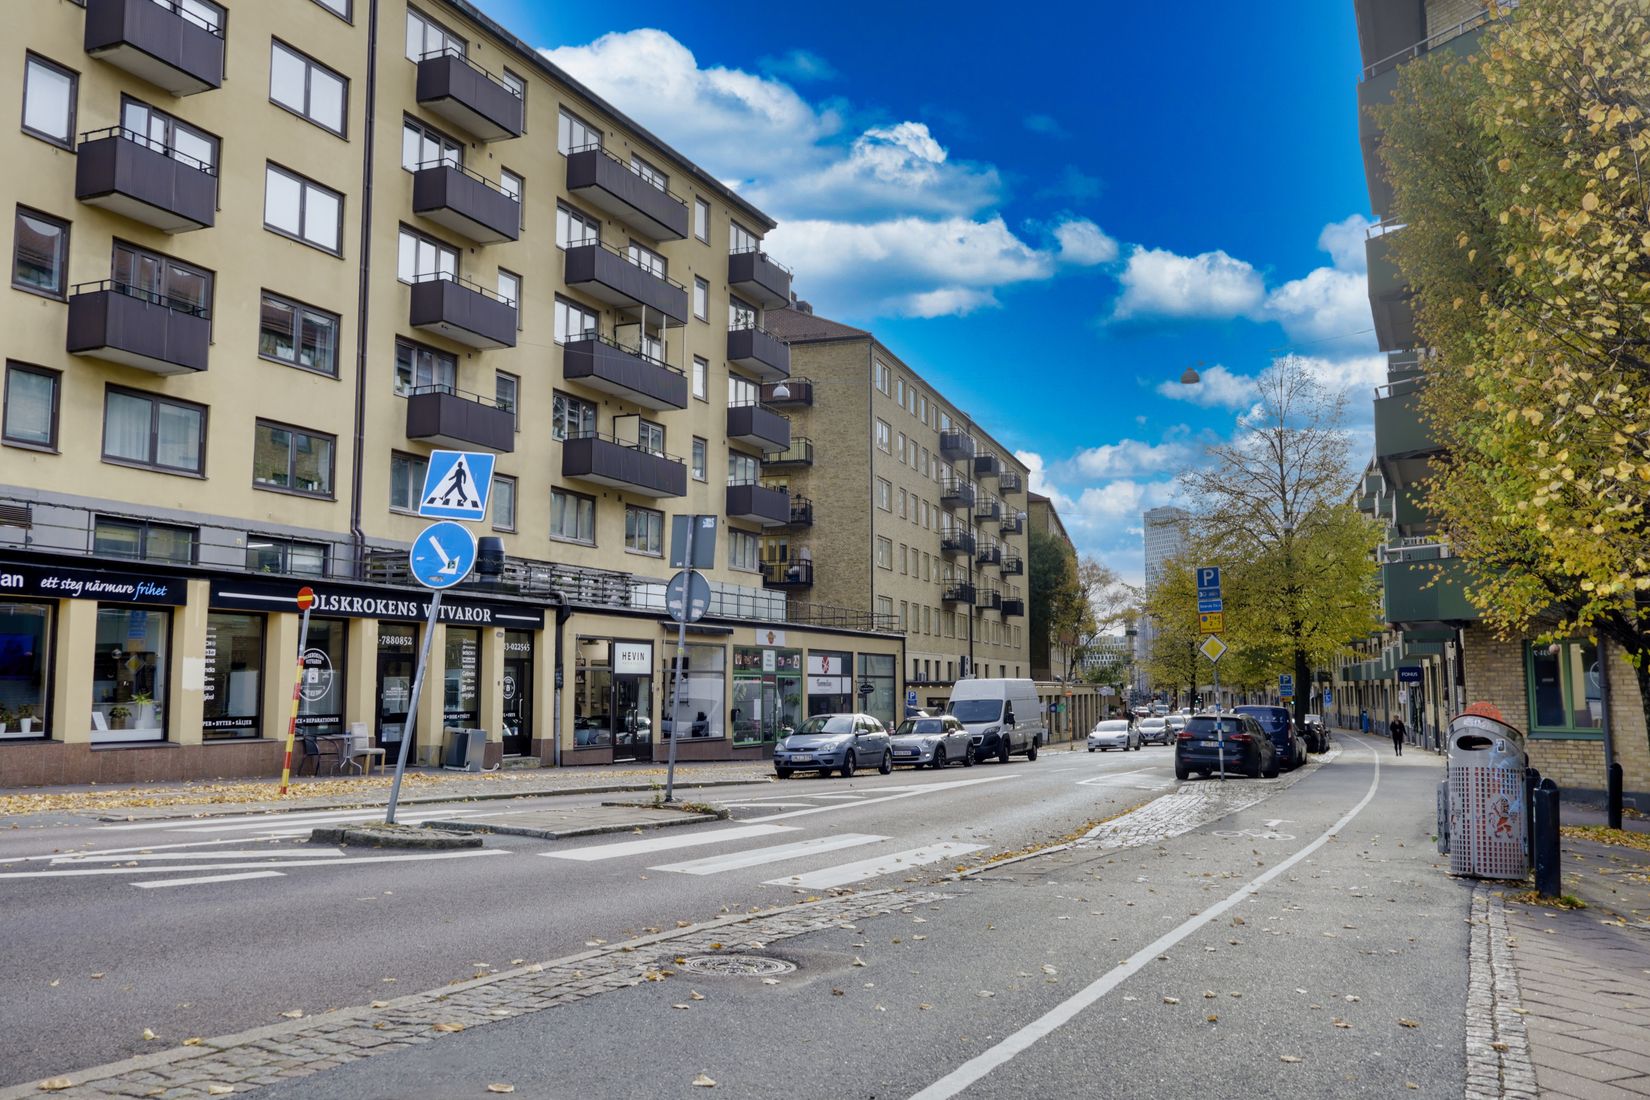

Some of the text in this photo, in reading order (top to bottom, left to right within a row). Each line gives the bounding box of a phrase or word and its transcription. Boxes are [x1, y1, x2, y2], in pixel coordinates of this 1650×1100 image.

[0, 571, 24, 588] an
[40, 576, 168, 600] ett steg närmare frihet
[422, 603, 492, 622] VTVAROR
[377, 635, 413, 646] -7880852
[622, 652, 645, 661] HEVIN
